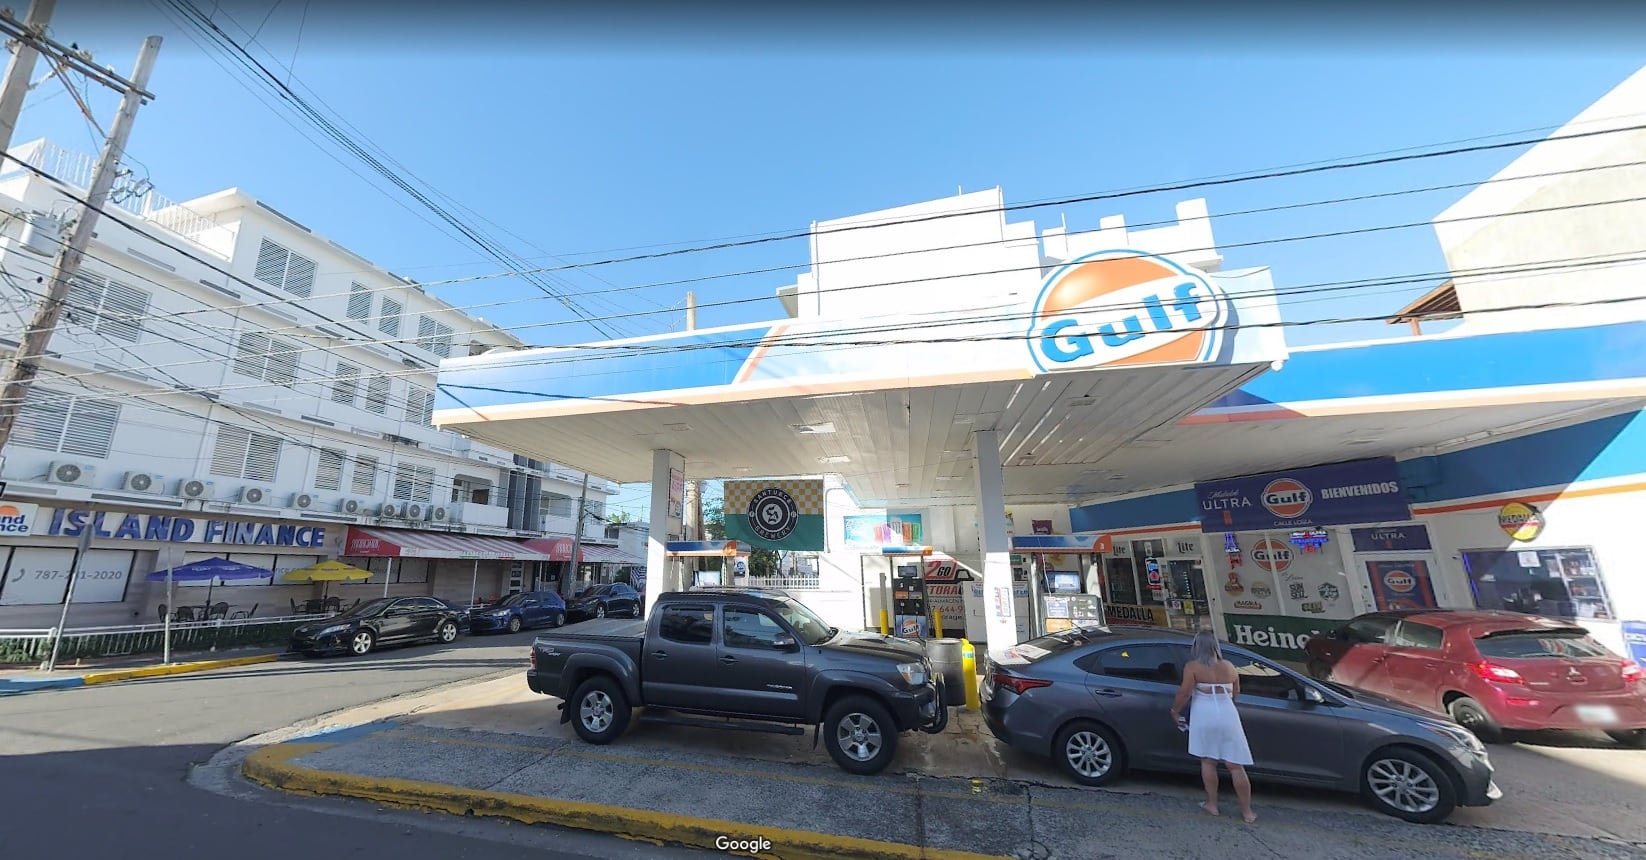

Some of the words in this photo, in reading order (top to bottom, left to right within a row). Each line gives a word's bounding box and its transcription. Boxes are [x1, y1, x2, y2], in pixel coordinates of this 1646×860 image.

[1040, 282, 1202, 363] Gulf
[753, 490, 792, 505] SANTURCE
[1266, 490, 1309, 505] Gulf
[1321, 481, 1399, 500] BIENVENIDOS
[1202, 496, 1252, 511] ULTRA
[0, 515, 26, 524] nd
[49, 507, 195, 542] ISLAND
[204, 519, 327, 548] FINANCE
[754, 524, 791, 538] BREWERY
[1371, 533, 1407, 541] ULTRA
[1113, 545, 1126, 556] Lite
[1177, 542, 1194, 554] Lite
[1254, 550, 1292, 561] Gulf
[1386, 577, 1412, 586] Gulf
[1106, 605, 1154, 622] MEDALLA
